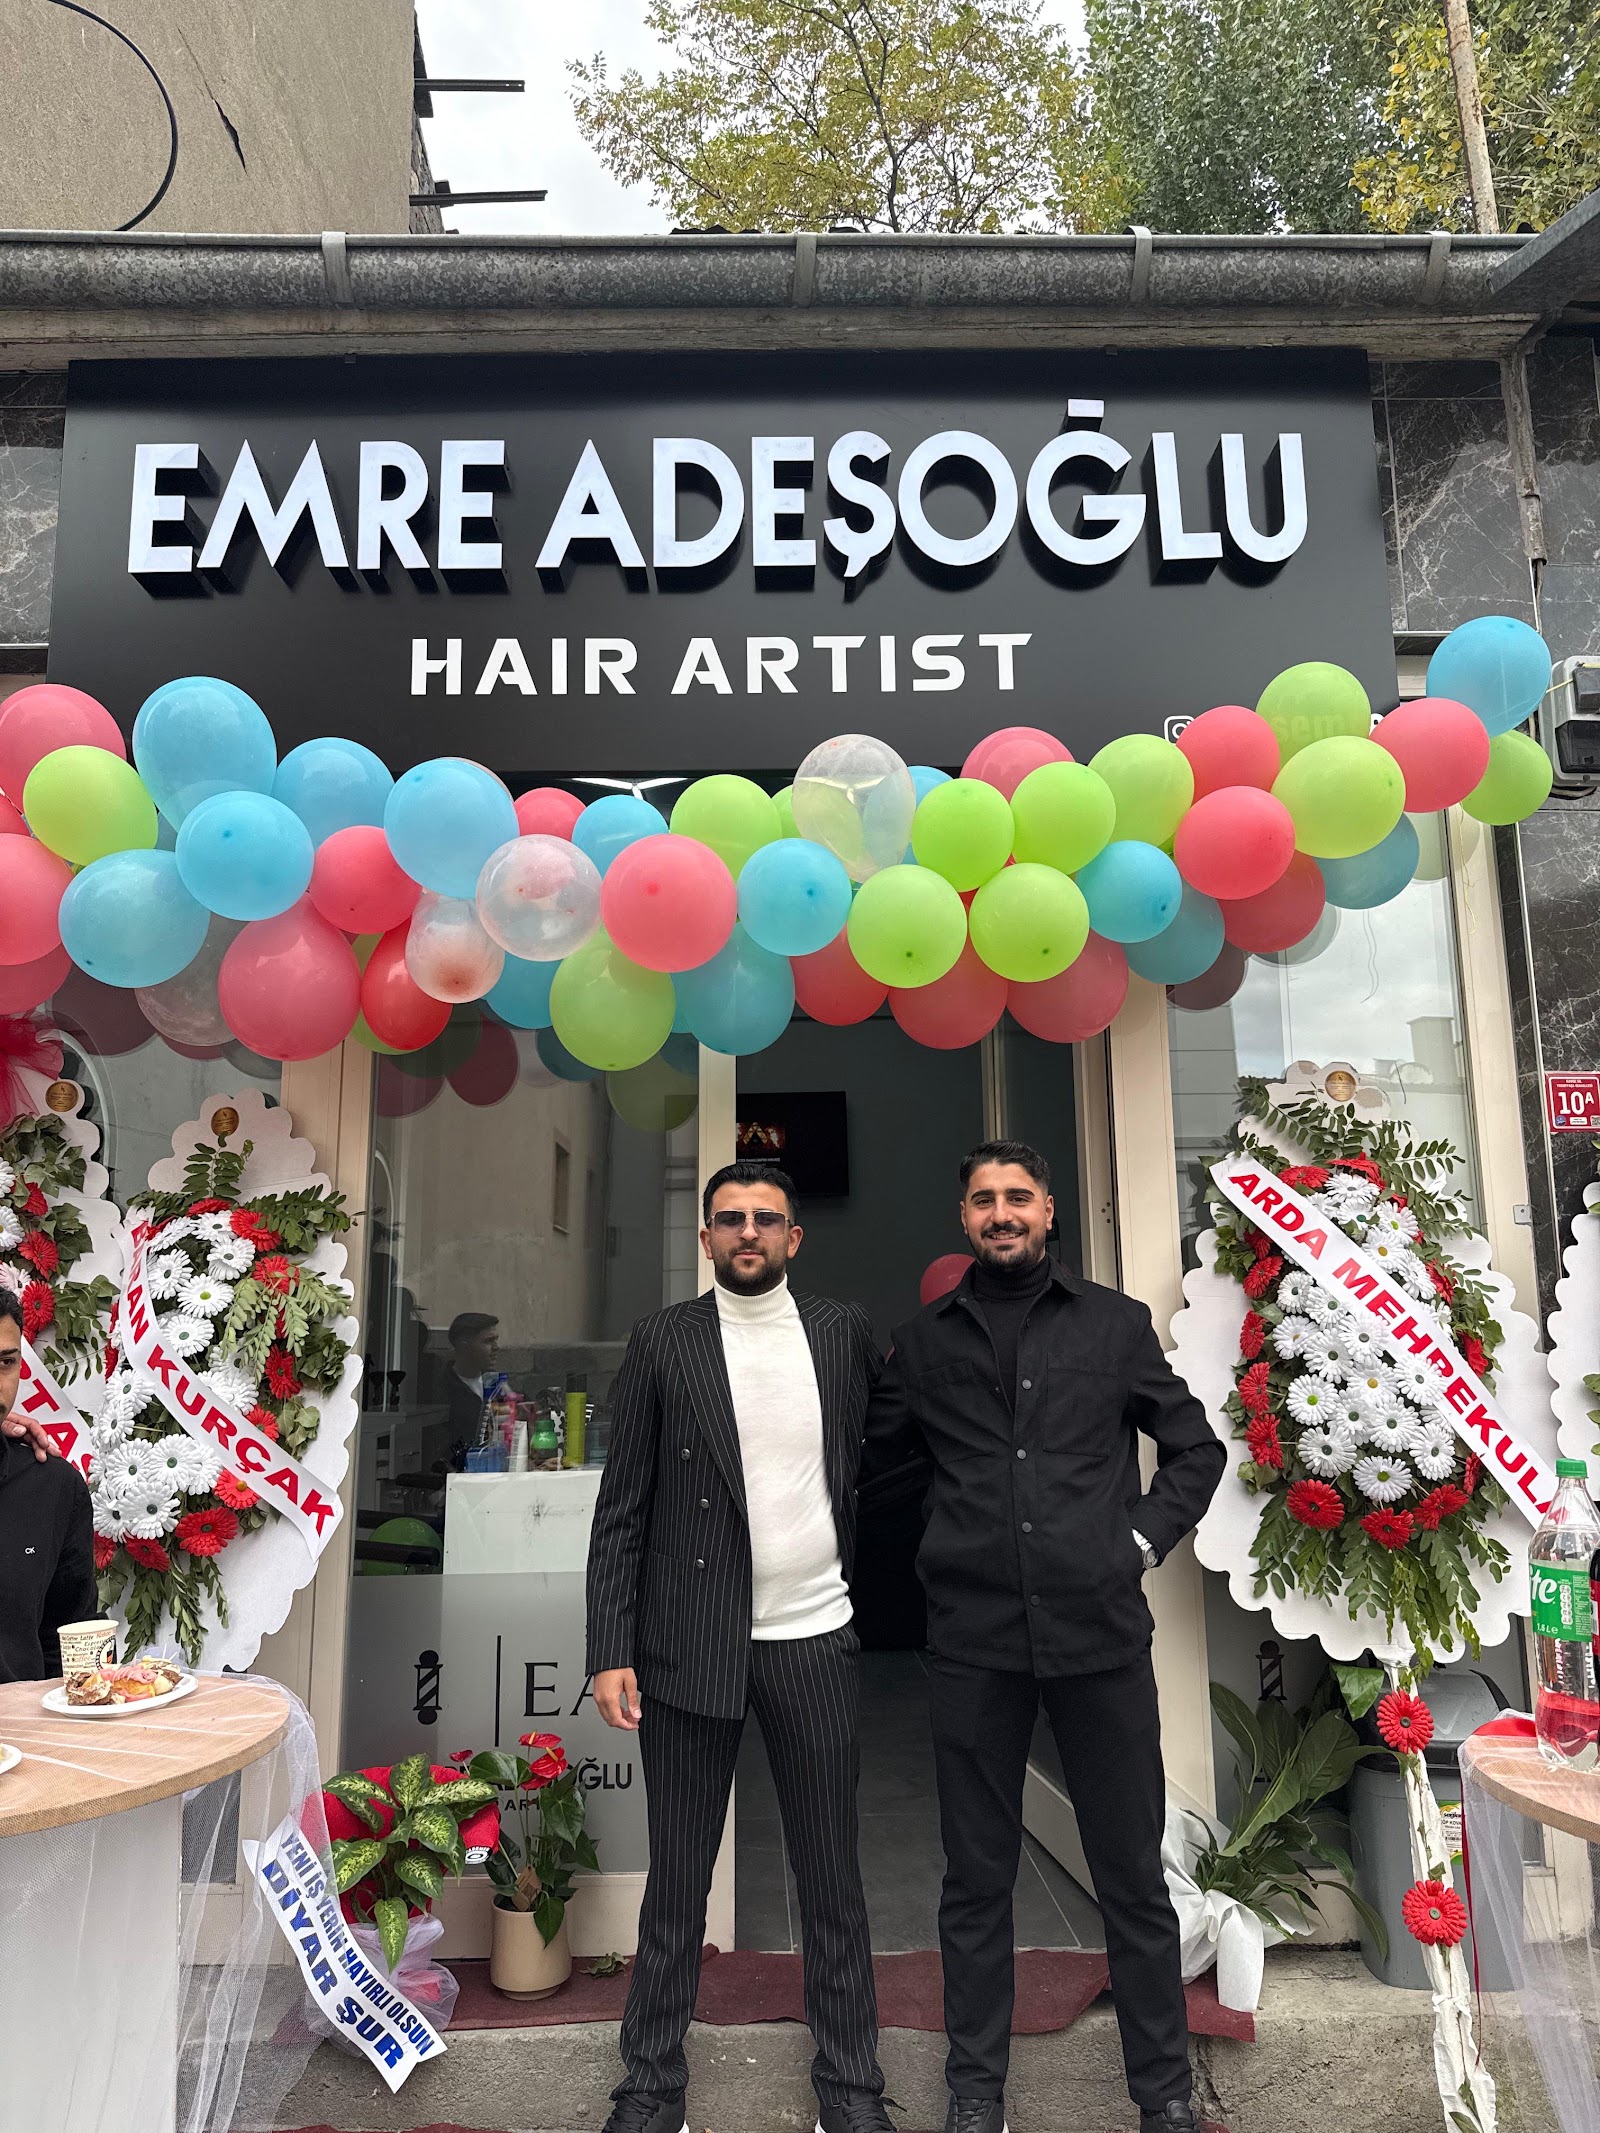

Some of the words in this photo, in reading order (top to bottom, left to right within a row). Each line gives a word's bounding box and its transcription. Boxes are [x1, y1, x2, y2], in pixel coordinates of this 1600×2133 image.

[128, 439, 505, 574] EMRE
[535, 399, 1309, 579] ADEŞOĞLU
[411, 638, 638, 696] HAIR
[671, 633, 1033, 695] ARTIST
[1228, 1173, 1329, 1261] ARDA
[146, 1343, 335, 1537] KURÇAK
[24, 1546, 36, 1555] CK
[261, 1858, 338, 1996] DİYAR
[336, 1996, 406, 2069] ŞUR
[281, 1833, 317, 1878] YENİ
[303, 1871, 325, 1899] İŞ
[315, 1896, 350, 1953] YERİN
[341, 1947, 393, 2012] HAYIRLI
[386, 2002, 436, 2056] OLSUN
